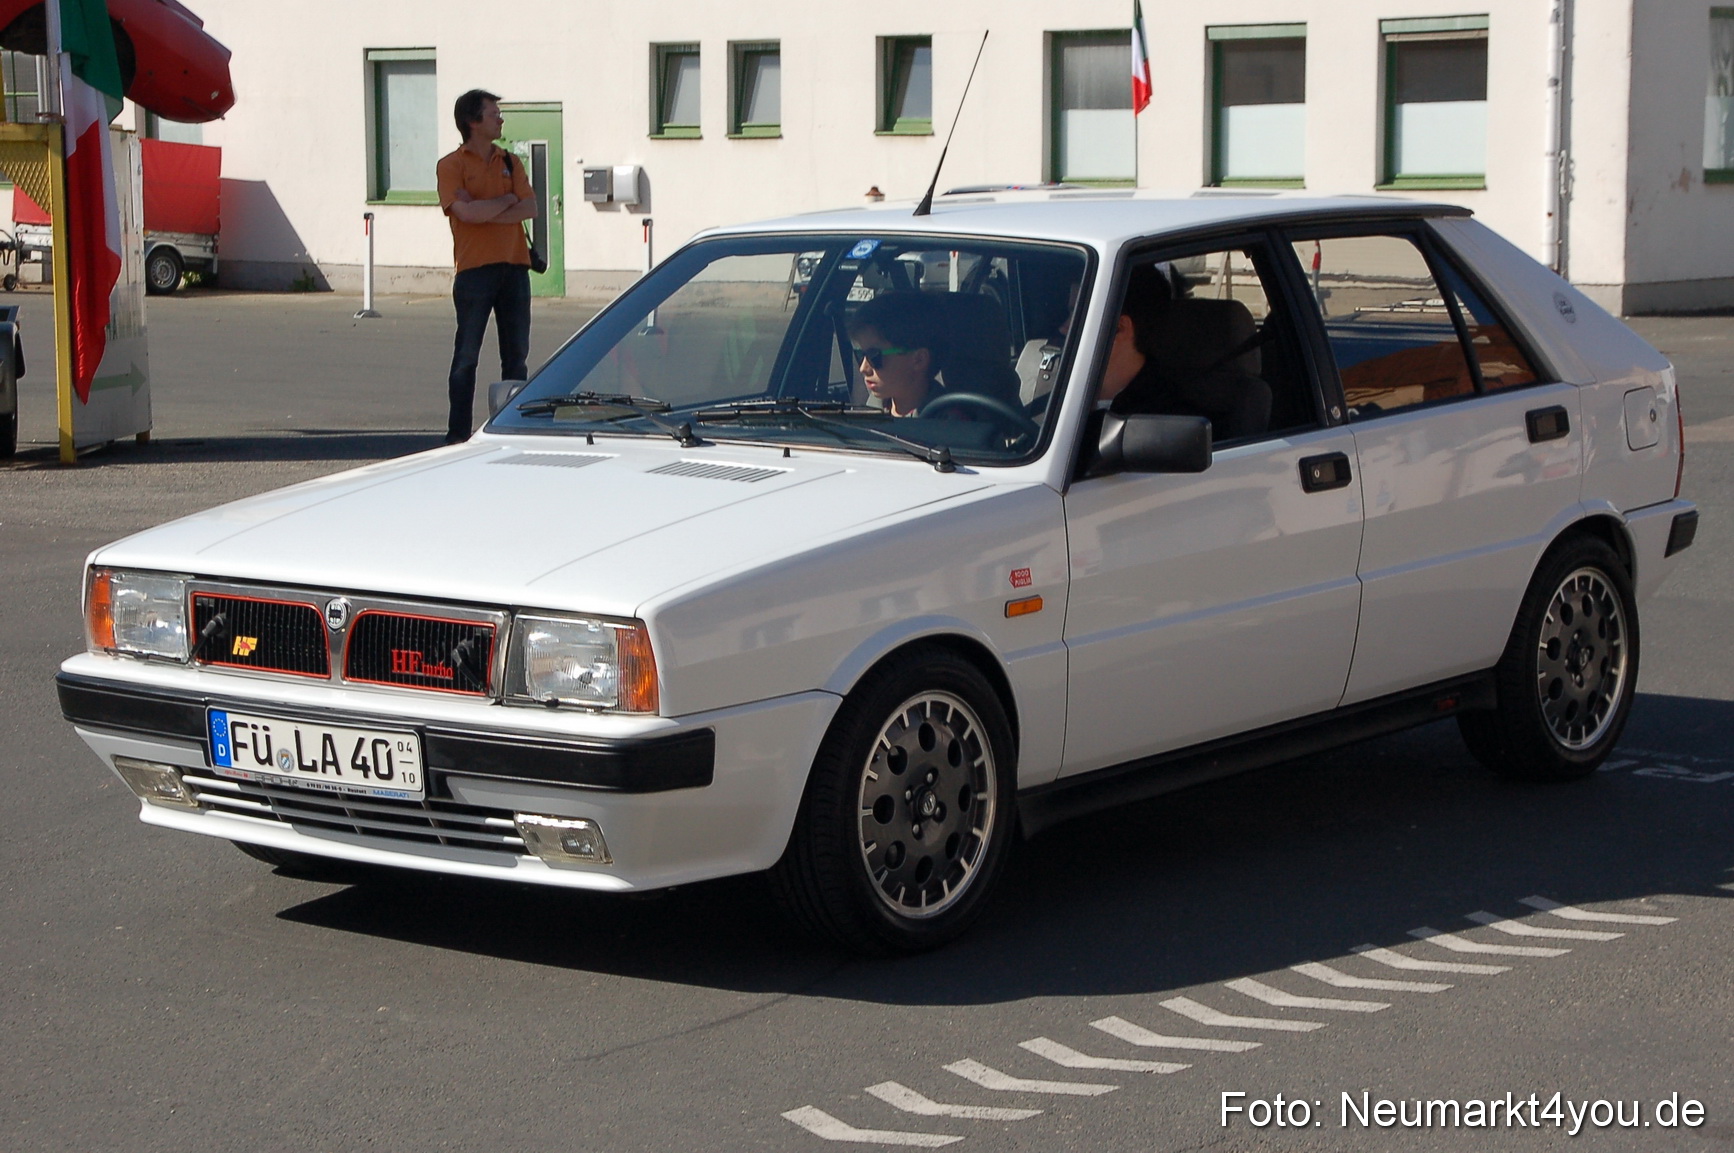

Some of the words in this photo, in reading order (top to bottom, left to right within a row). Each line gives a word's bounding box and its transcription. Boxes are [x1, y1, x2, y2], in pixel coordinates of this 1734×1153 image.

[391, 649, 423, 673] HF
[422, 661, 454, 679] turbo
[218, 744, 226, 757] D
[230, 720, 273, 767] FÜ
[294, 728, 342, 776] LA
[351, 737, 394, 781] 40
[397, 741, 413, 753] 04
[401, 772, 416, 784] 10
